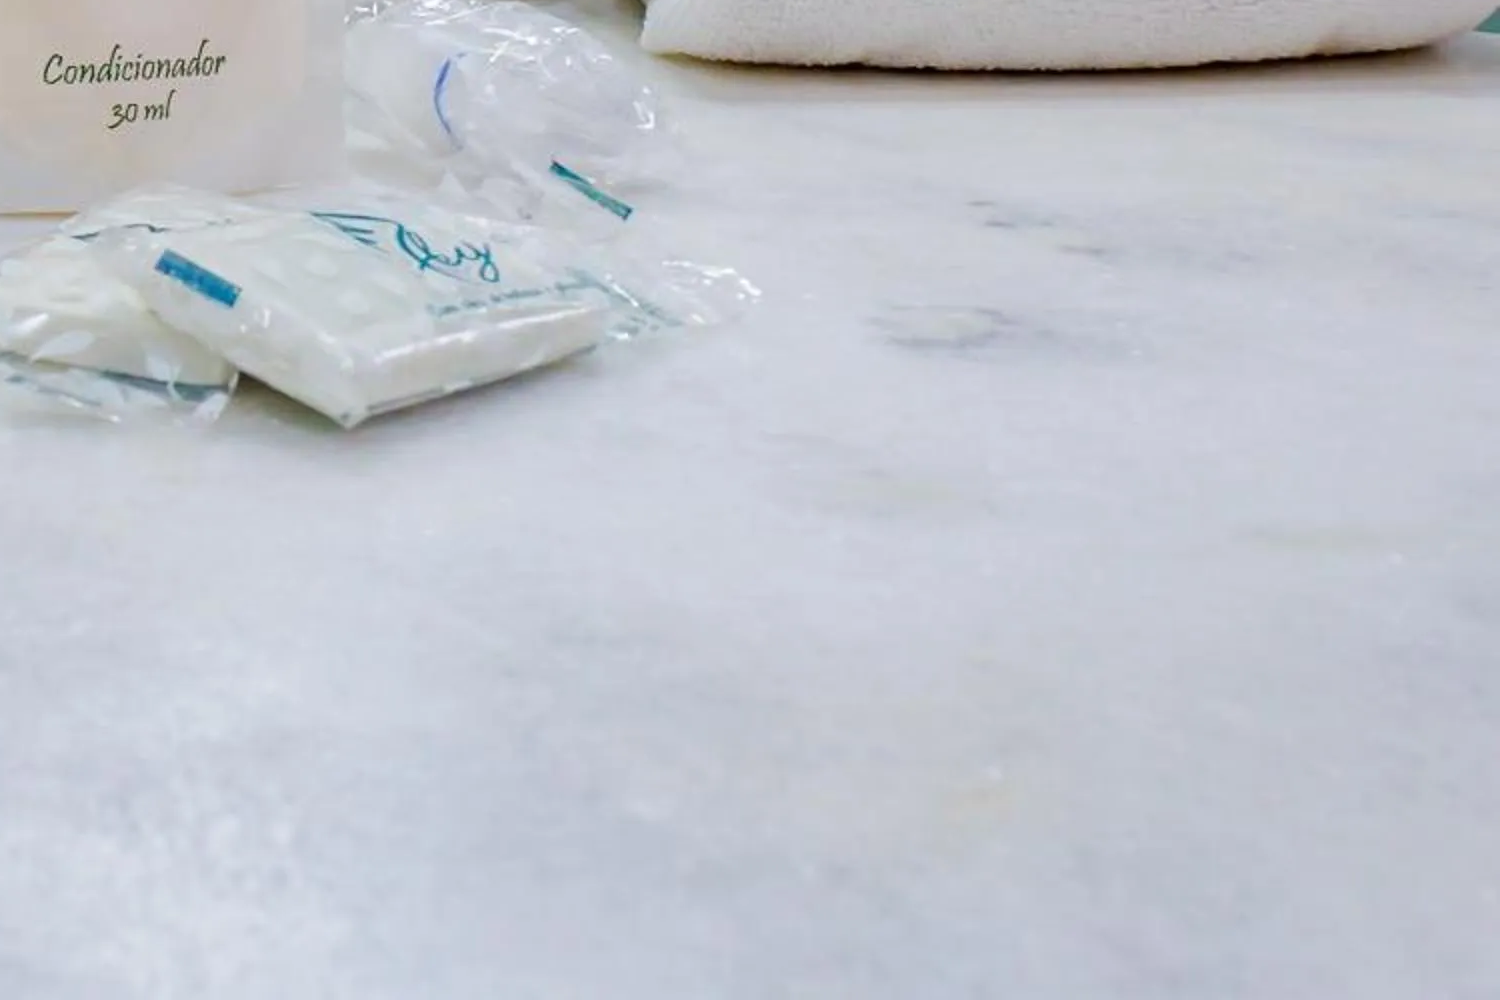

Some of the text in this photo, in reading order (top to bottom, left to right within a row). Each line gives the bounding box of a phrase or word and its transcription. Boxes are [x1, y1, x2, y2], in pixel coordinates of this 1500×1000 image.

[43, 39, 226, 85] Condicionador
[108, 89, 176, 129] 30 ml
